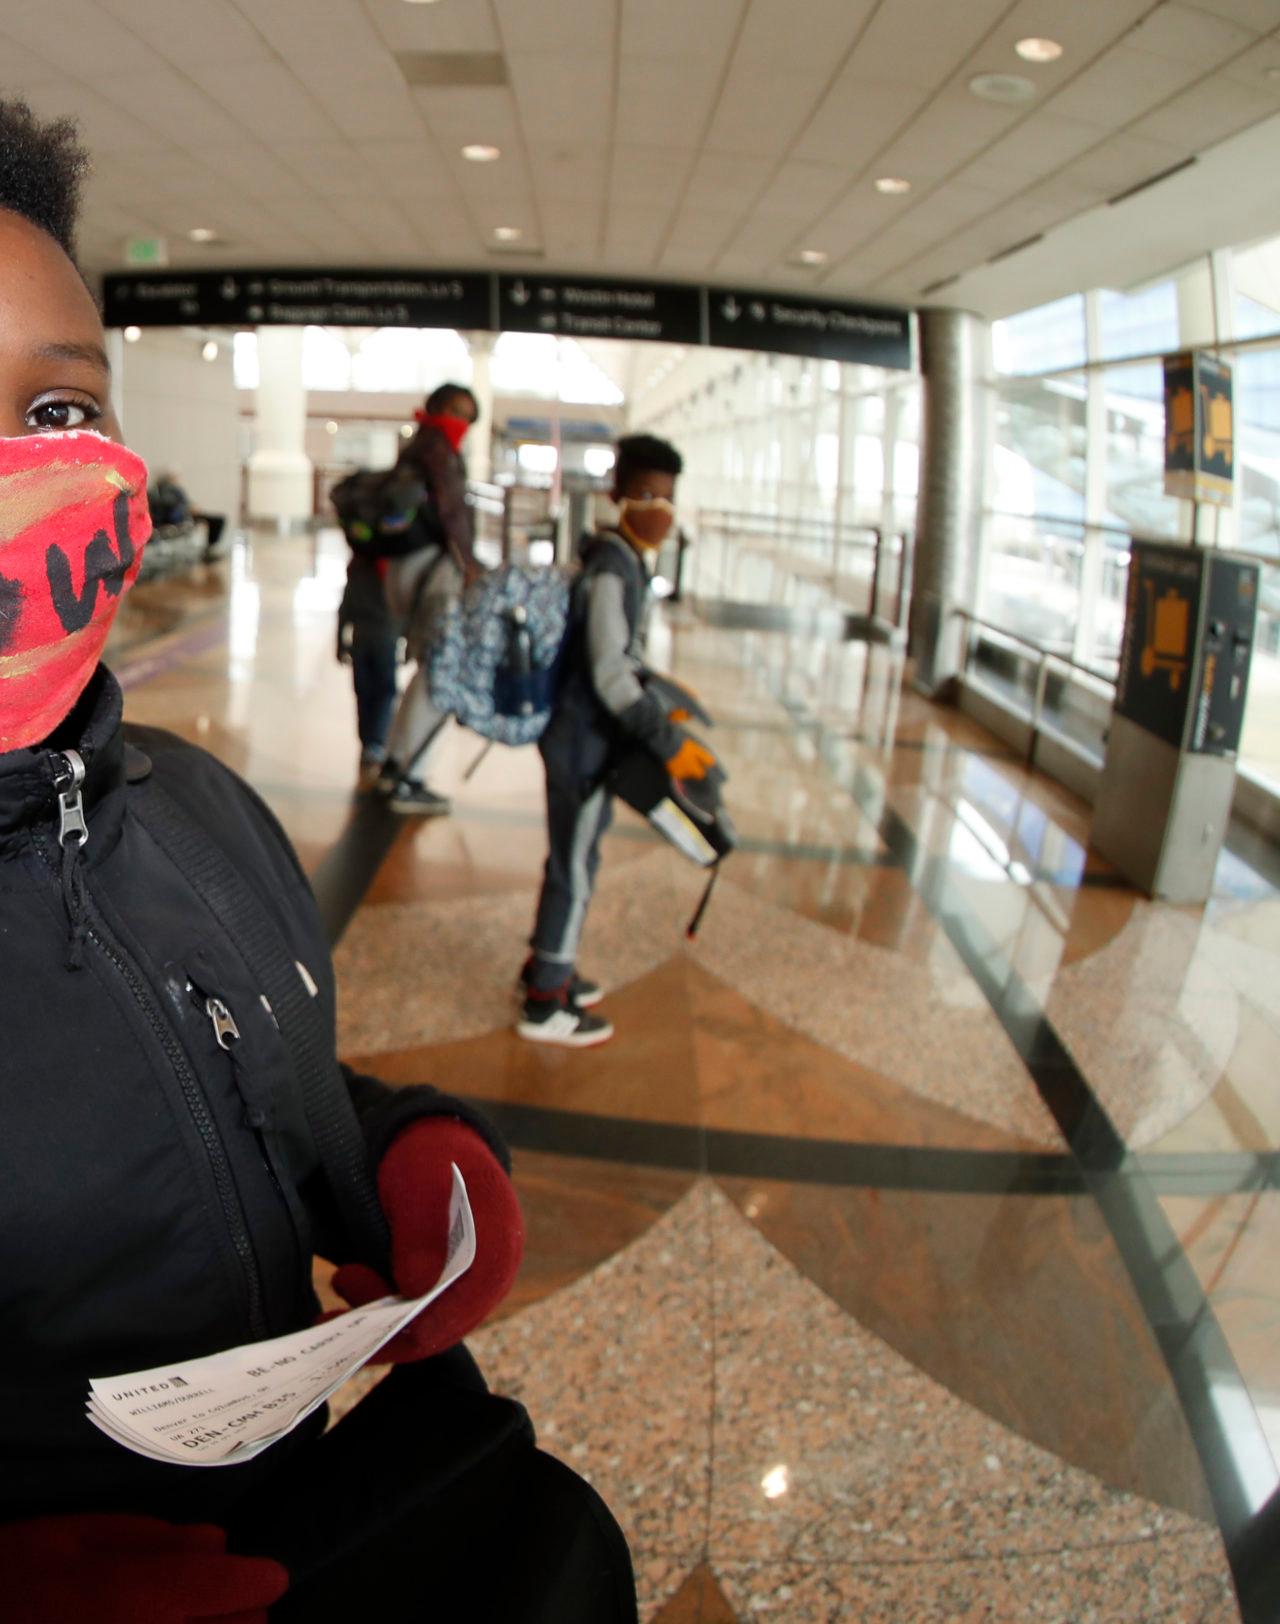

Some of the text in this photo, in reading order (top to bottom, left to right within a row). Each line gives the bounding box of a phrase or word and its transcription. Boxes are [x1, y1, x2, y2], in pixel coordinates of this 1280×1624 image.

[772, 303, 828, 330] Security
[112, 1382, 170, 1401] UNITED
[182, 1410, 264, 1448] DEN-CMH
